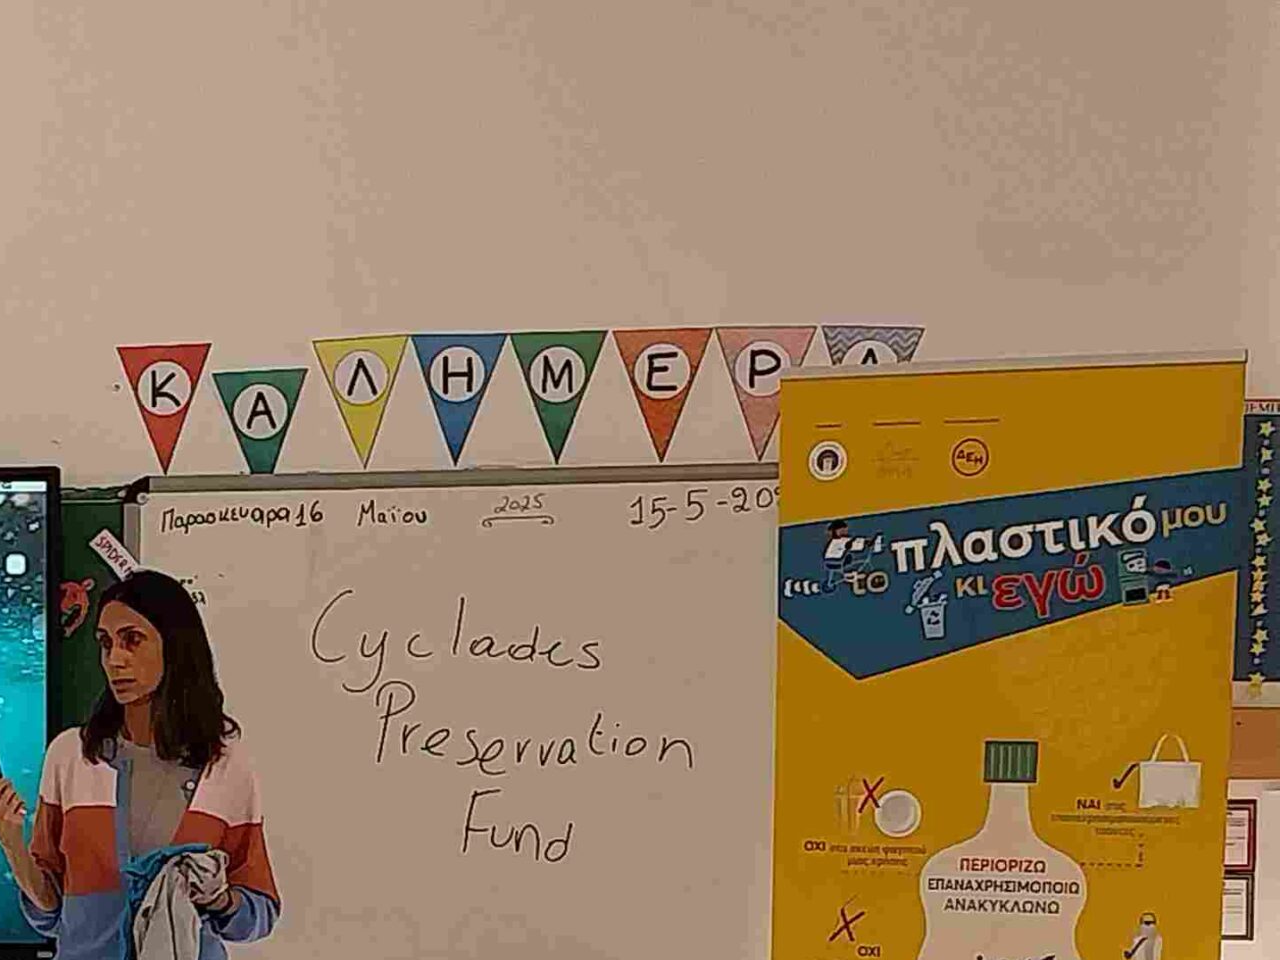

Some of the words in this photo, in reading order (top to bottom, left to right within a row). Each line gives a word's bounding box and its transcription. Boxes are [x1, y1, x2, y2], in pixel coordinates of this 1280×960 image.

[956, 449, 983, 466] ΔΕΗ
[493, 493, 545, 514] 2025
[891, 495, 1156, 574] πλαστικό
[1161, 502, 1226, 538] μου
[850, 571, 889, 595] το
[993, 552, 1105, 618] εγώ
[311, 589, 602, 693] Cyclades
[375, 680, 694, 776] Preservation
[1077, 799, 1101, 810] ΝΑΙ
[462, 789, 573, 862] Fund
[804, 840, 826, 851] ΟΧΙ
[960, 858, 1046, 873] ΠΕΡΙΟΡΙΖΩ
[927, 878, 1080, 894] ΕΠΑΝΑΧΡΗΣΙΜΟΠΟΙΩ
[944, 898, 1060, 914] ΑΝΑΚΥΚΛΩΝΩ
[858, 946, 881, 957] ΟΧΙ
